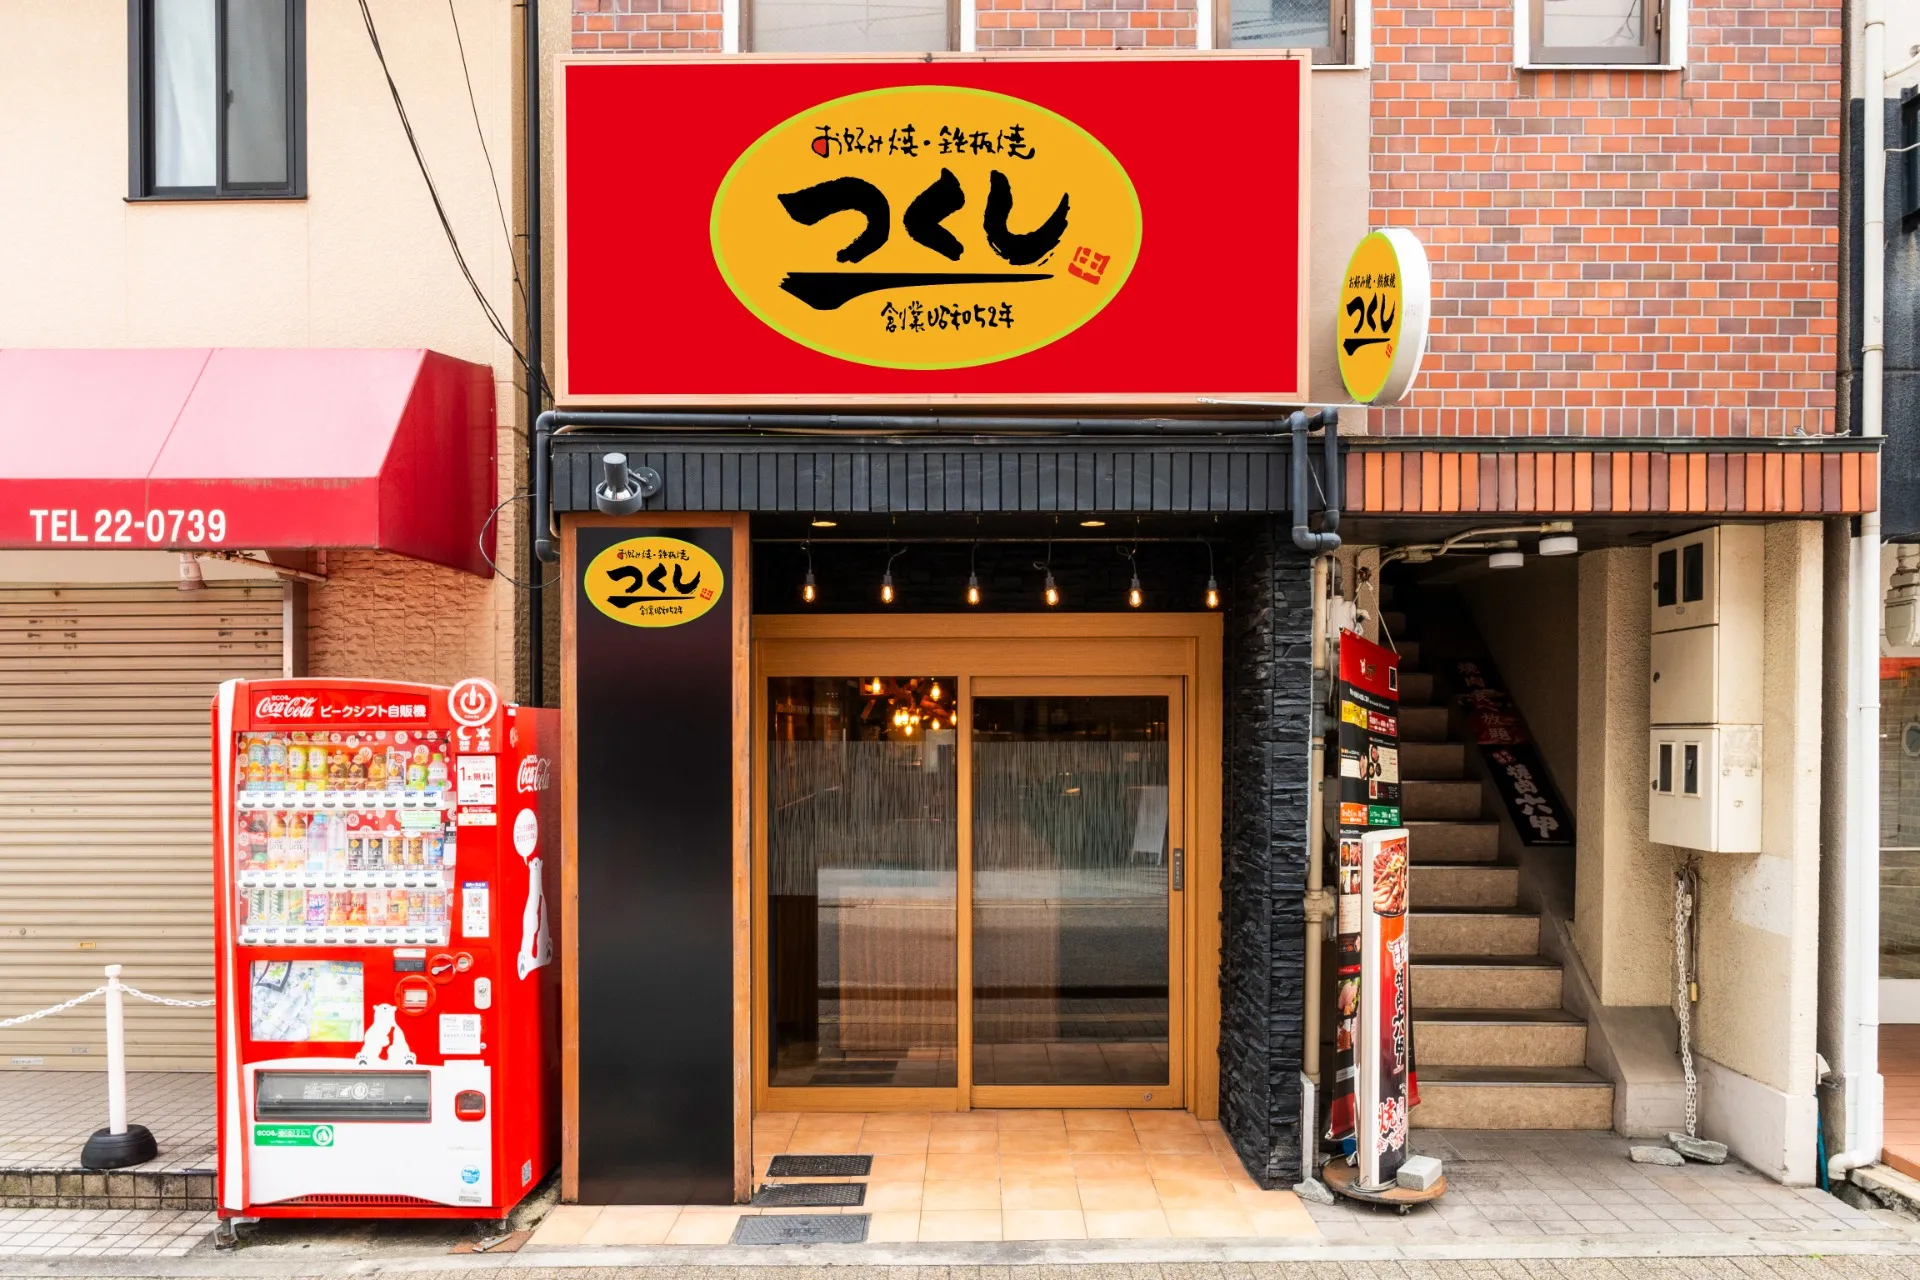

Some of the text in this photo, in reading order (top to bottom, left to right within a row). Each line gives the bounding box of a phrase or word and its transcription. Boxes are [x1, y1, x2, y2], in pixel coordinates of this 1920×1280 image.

[811, 123, 1036, 160] お好み焼・鉄板焼
[777, 167, 1071, 267] つくし
[1348, 272, 1396, 290] お好み焼・鉄板焼
[880, 301, 1015, 333] 創業昭和52年
[1346, 292, 1396, 334] つくし
[29, 509, 226, 542] TEL 22-0739
[606, 563, 701, 595] つくし
[255, 696, 318, 718] Coca-Cola
